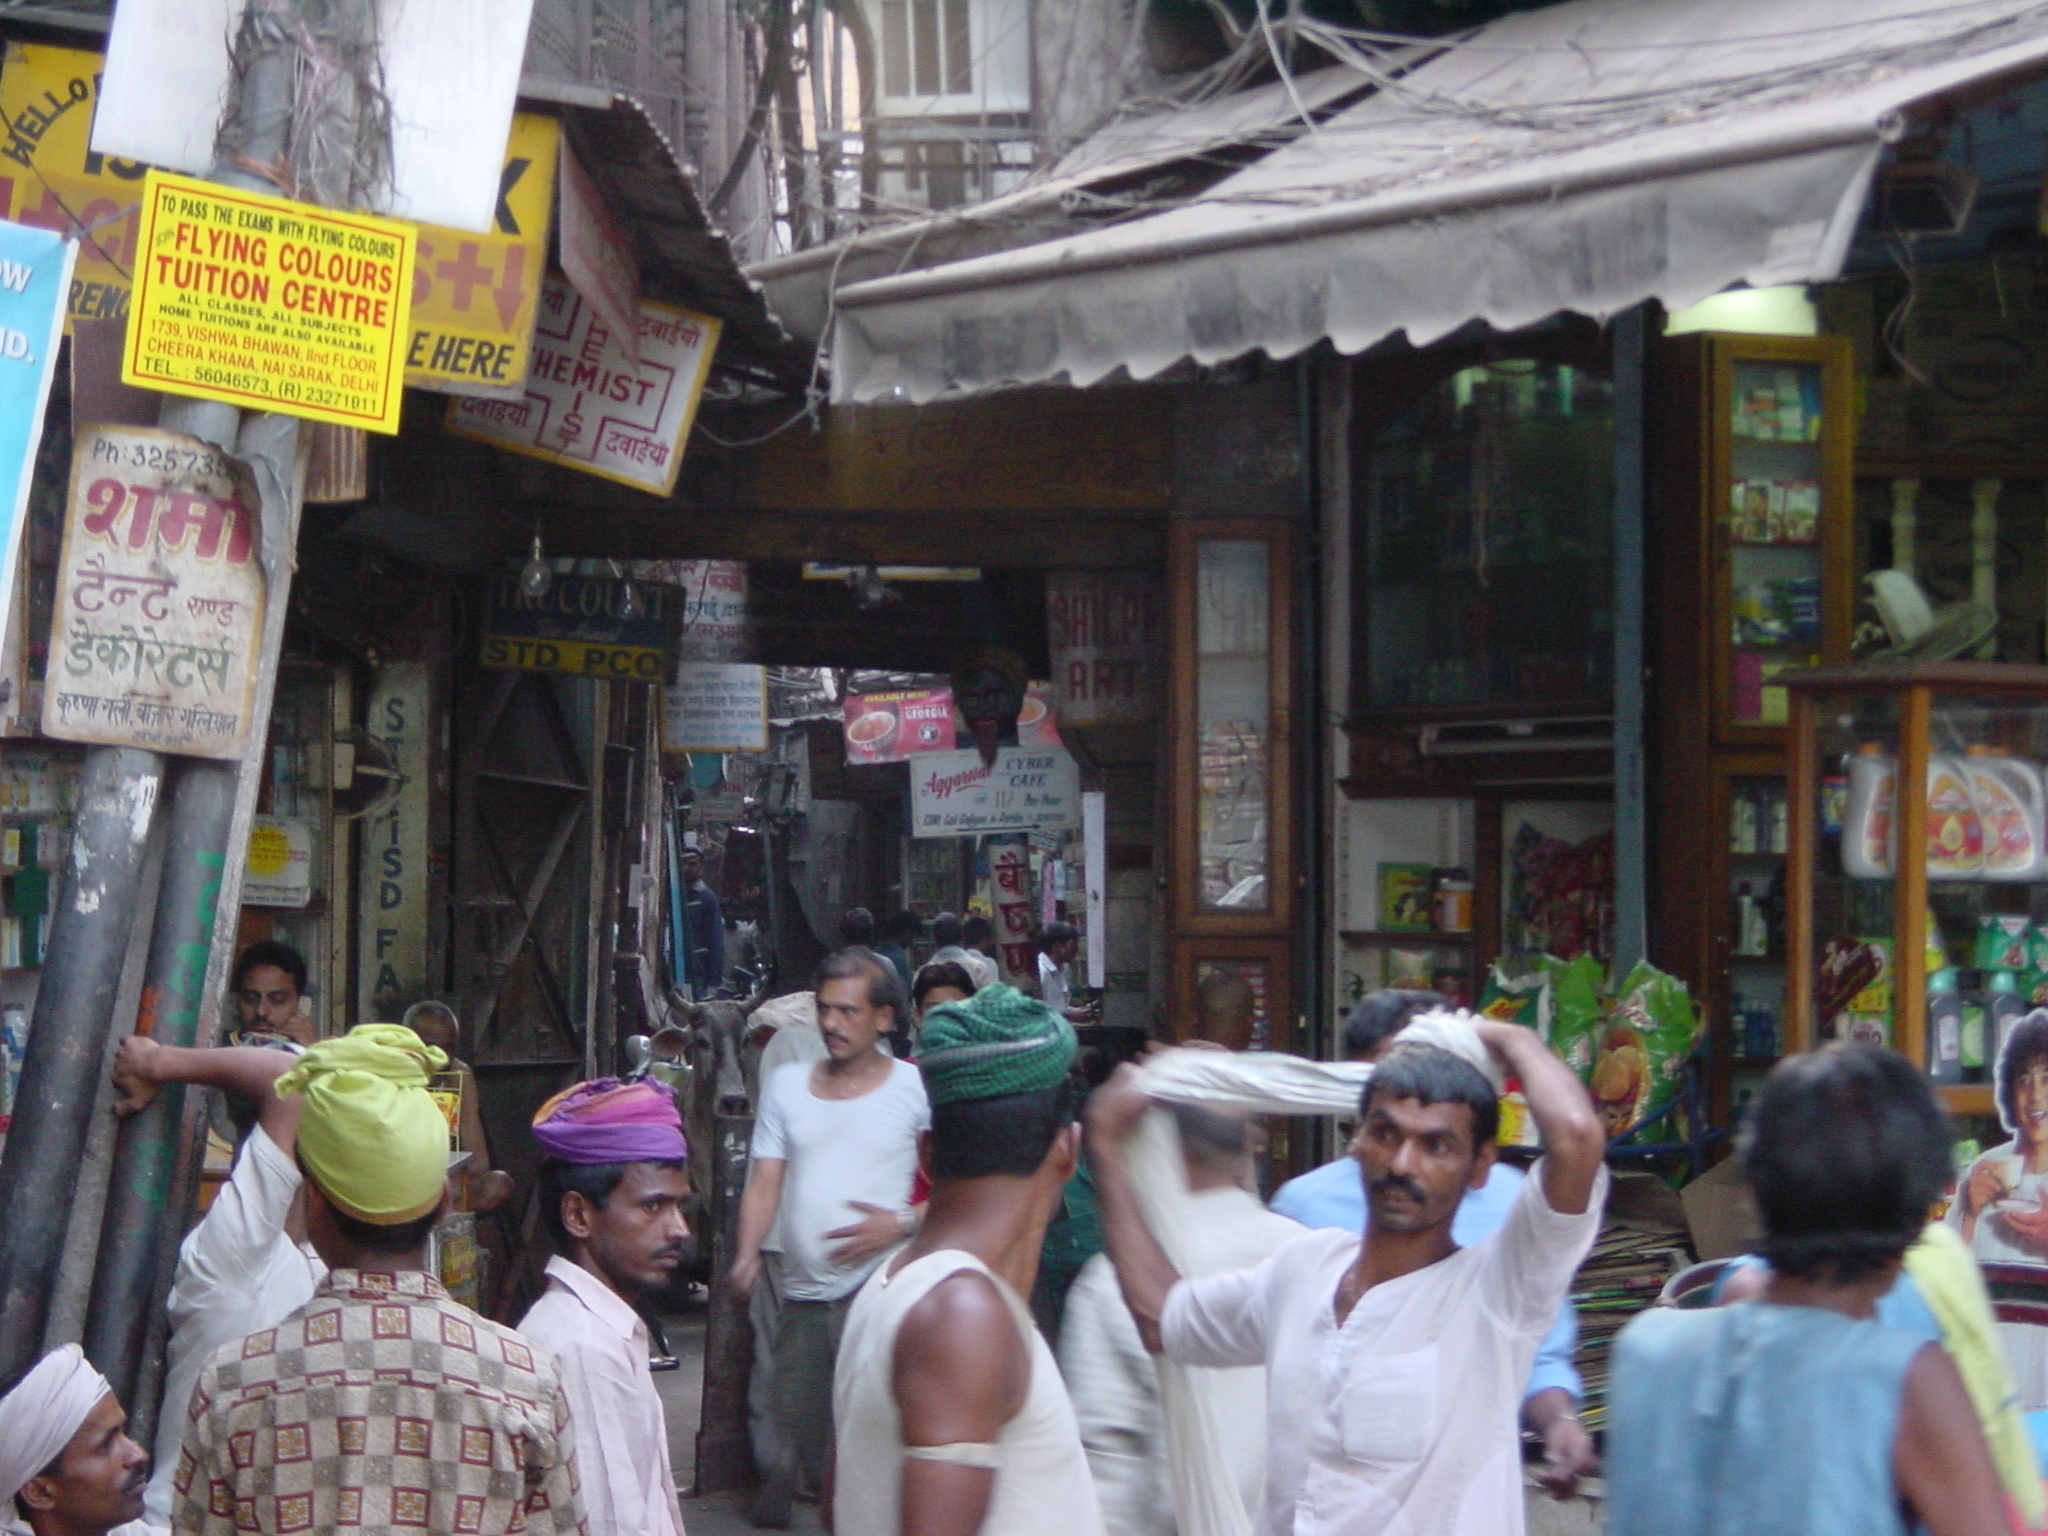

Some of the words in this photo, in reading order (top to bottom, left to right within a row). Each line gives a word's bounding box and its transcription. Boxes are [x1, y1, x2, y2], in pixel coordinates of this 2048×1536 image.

[1, 77, 89, 168] HELLO
[161, 194, 175, 214] TO
[180, 201, 207, 220] PASS
[213, 205, 233, 225] THE
[238, 210, 273, 232] EXAMS
[278, 219, 304, 237] WITH
[308, 225, 345, 248] FLYING
[348, 233, 396, 260] COLOURS
[0, 258, 33, 293] W
[175, 222, 267, 267] FLYING
[279, 243, 392, 294] COLOURS
[156, 254, 270, 304] TUITION
[282, 280, 388, 328] CENTRE
[150, 319, 184, 338] 1739,
[187, 325, 238, 348] VISHWA
[159, 304, 191, 319] HOME
[198, 311, 250, 330] TUITIONS
[255, 323, 277, 335] ARE
[283, 328, 311, 341] ALSO
[316, 334, 376, 354] AVAILABLE
[178, 293, 200, 305] ALL
[207, 299, 265, 319] CLASSES,
[272, 311, 293, 324] ALL
[300, 317, 361, 337] SUBJECTS
[147, 338, 203, 360] CHEERA
[262, 358, 285, 374] NAI
[340, 373, 379, 393] DELHI
[430, 335, 515, 380] HERE
[531, 346, 655, 406] HEMIST
[278, 383, 301, 400] (R)
[487, 636, 560, 669] STD
[583, 649, 661, 678] PCO
[904, 708, 948, 720] GEORGIA
